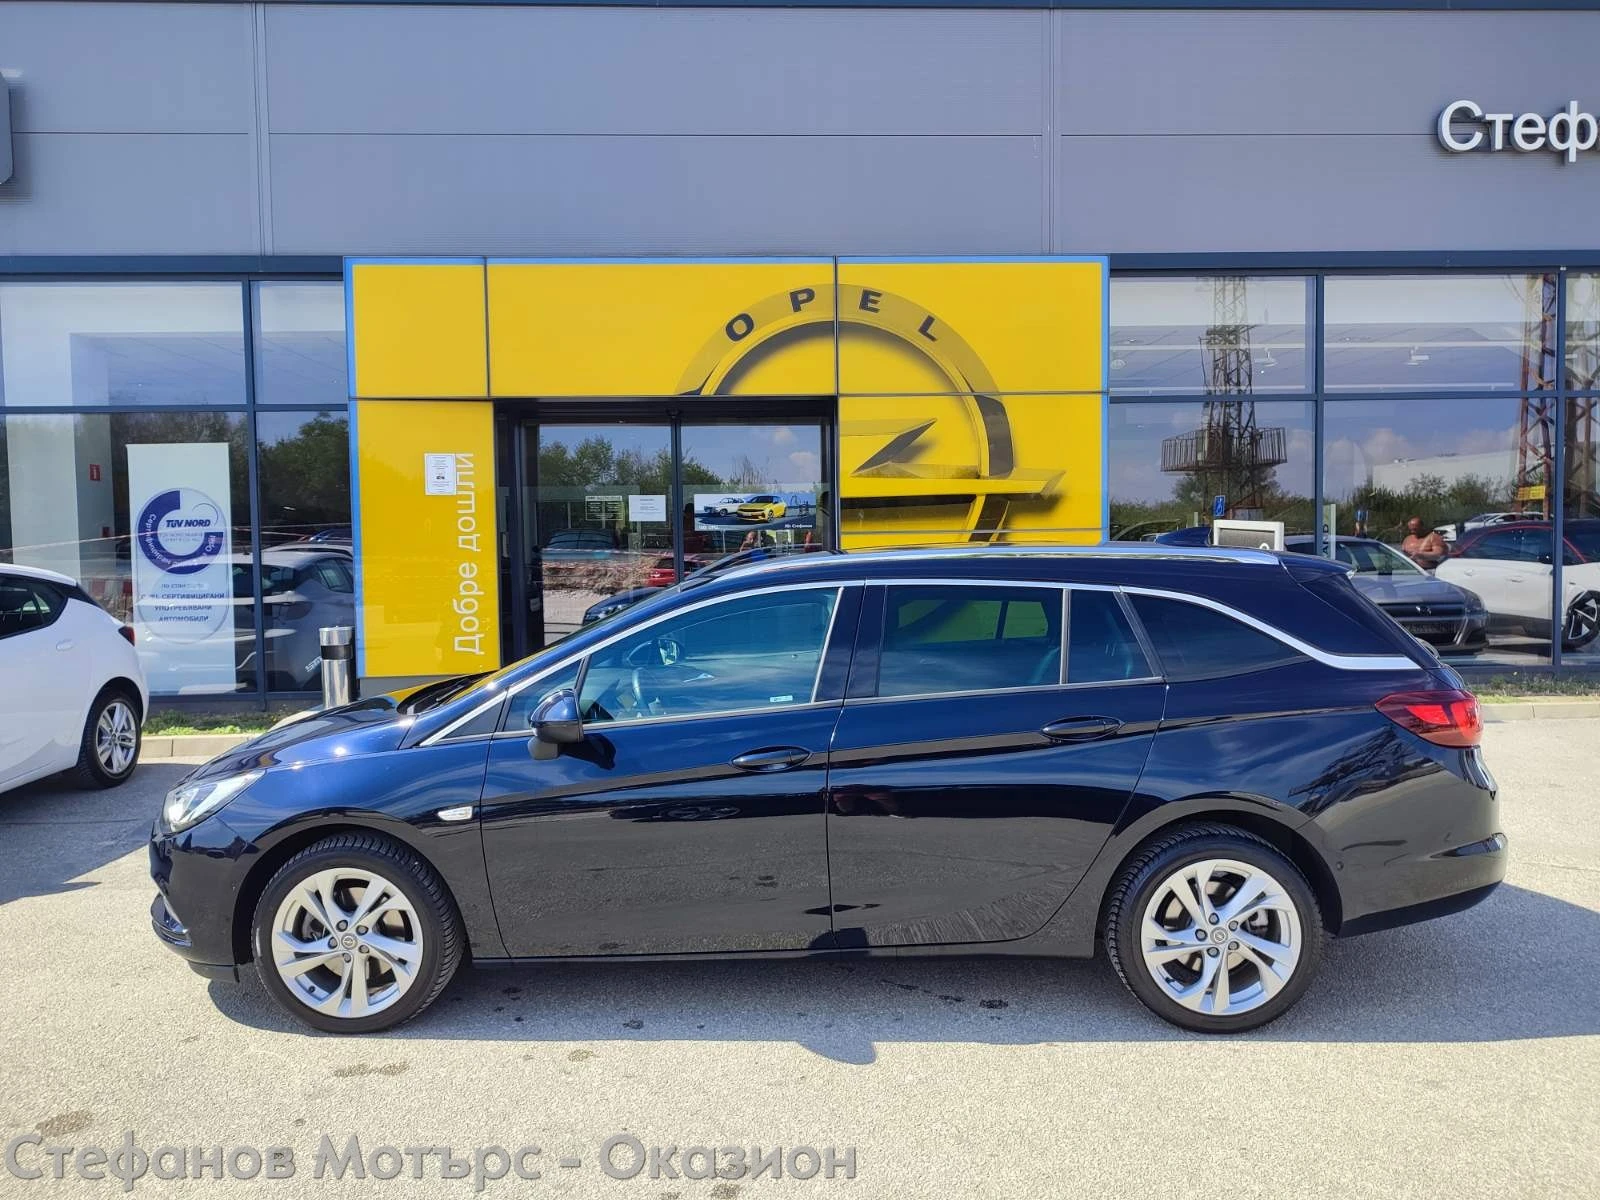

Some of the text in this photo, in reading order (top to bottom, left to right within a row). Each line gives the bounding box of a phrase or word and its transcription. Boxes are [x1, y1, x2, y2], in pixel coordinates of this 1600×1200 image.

[1438, 99, 1600, 163] Стеф
[725, 287, 939, 342] OPEL
[166, 519, 211, 528] TÜV NORD
[453, 453, 485, 655] Добре дошли
